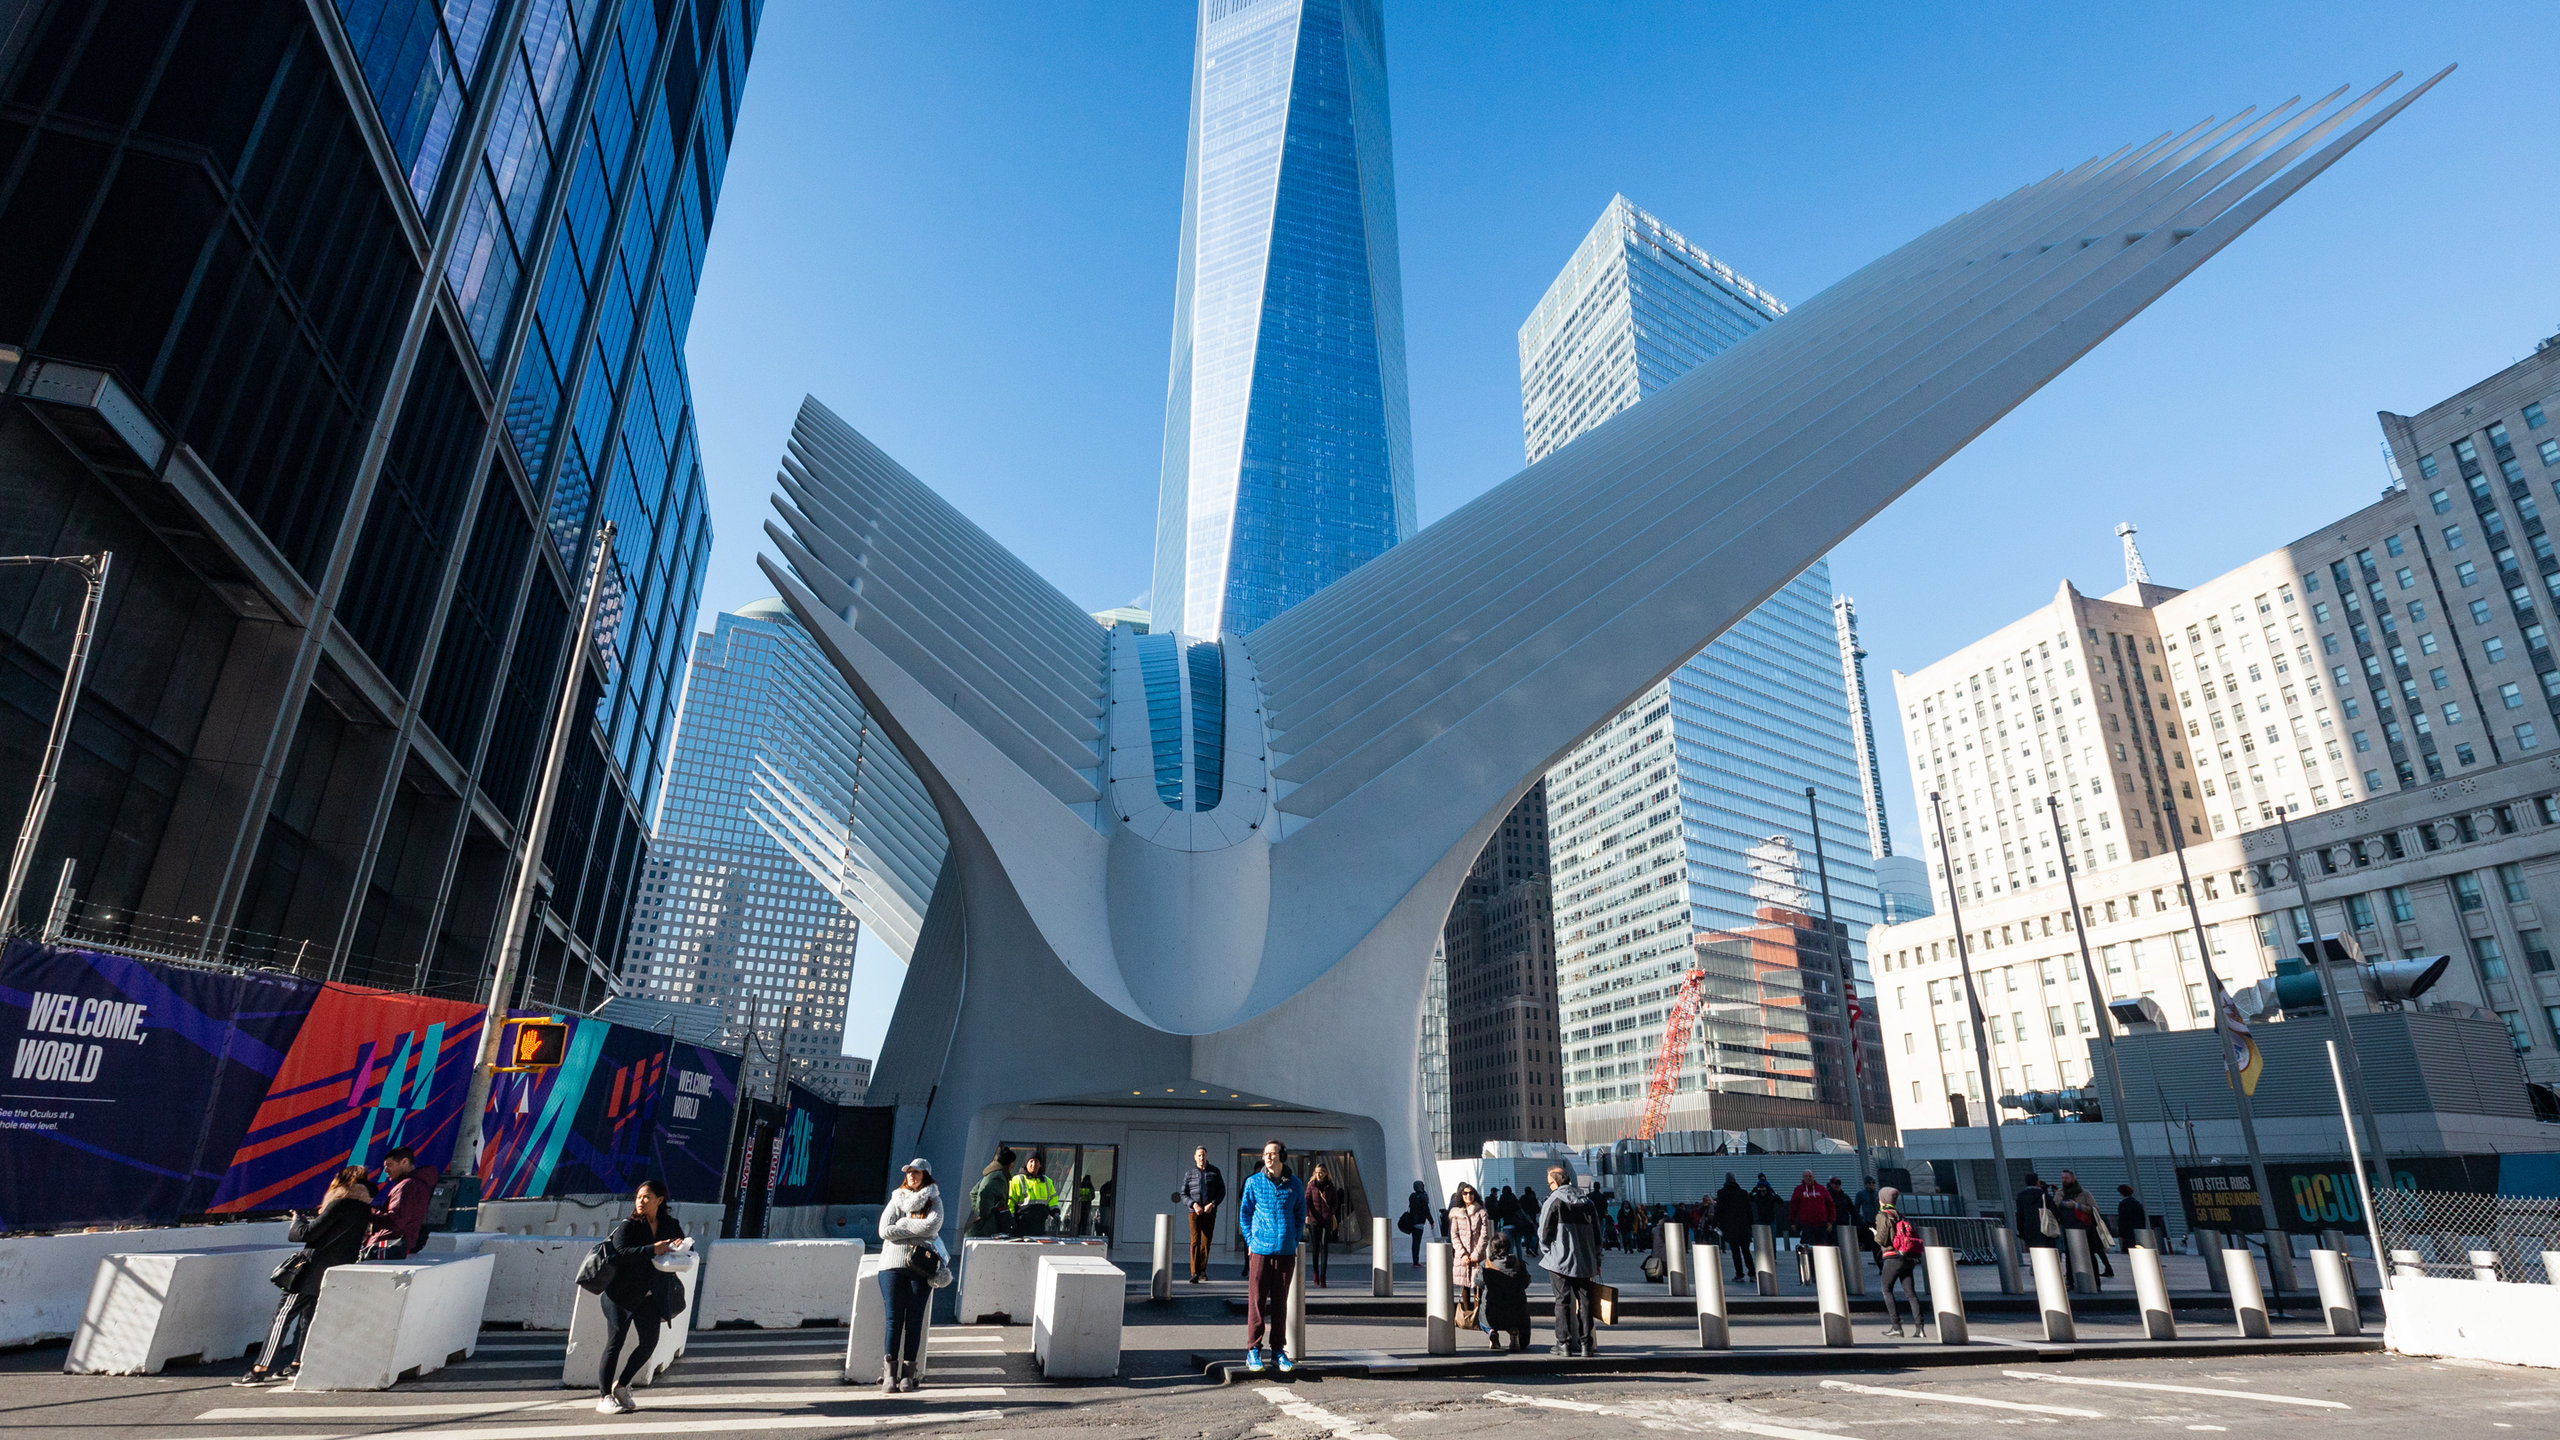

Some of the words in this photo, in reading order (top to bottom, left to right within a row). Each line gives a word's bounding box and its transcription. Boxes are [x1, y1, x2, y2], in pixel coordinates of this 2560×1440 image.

[27, 991, 148, 1045] WELCOME,
[12, 1038, 103, 1083] WORLD
[678, 1070, 713, 1099] WELCOME,
[14, 1109, 29, 1118] the
[30, 1109, 58, 1119] Oculus
[59, 1111, 68, 1119] at
[673, 1095, 700, 1120] WORLD
[0, 1120, 18, 1129] hole
[19, 1122, 38, 1130] new
[38, 1122, 58, 1130] level.
[2189, 1177, 2204, 1191] 110
[2205, 1177, 2229, 1191] STEEL
[2229, 1176, 2251, 1190] RIBS
[2192, 1192, 2214, 1206] EACH
[2215, 1191, 2262, 1206] AVERAGING
[2208, 1207, 2232, 1221] TONS
